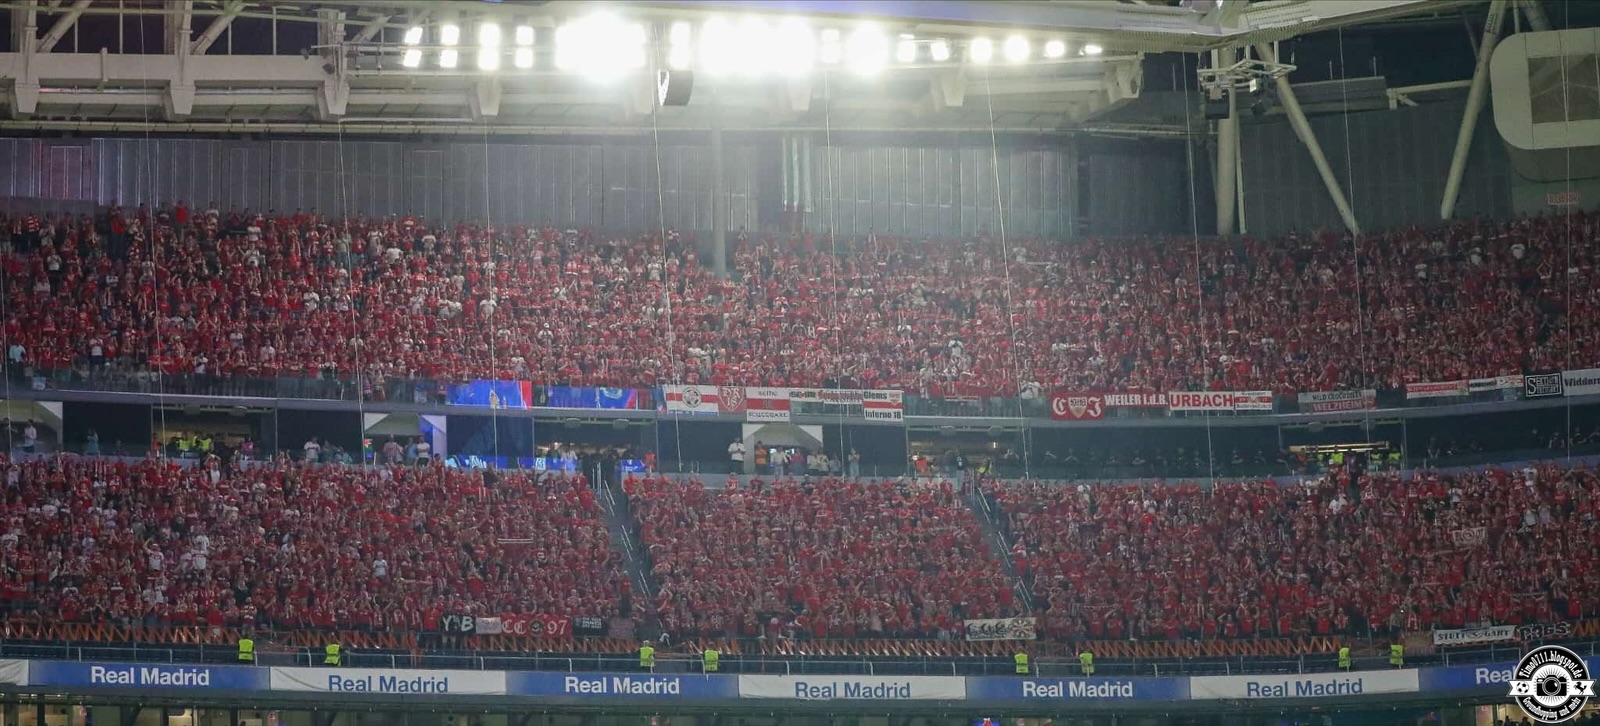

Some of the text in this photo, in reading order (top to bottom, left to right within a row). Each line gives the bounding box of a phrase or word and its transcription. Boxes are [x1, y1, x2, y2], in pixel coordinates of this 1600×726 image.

[1104, 394, 1141, 406] WEILER
[1170, 394, 1234, 408] URBACH
[1312, 400, 1363, 412] WELZHEIM
[865, 409, 892, 419] Inferno
[548, 620, 568, 635] 97
[1484, 629, 1509, 637] GART
[90, 665, 209, 687] Real Madrid
[328, 674, 448, 694] Real Madrid
[565, 675, 679, 695] Real Madrid
[795, 682, 910, 699] Real Madrid
[1022, 680, 1132, 699] Real Madrid
[1247, 677, 1363, 699] Real Madrid
